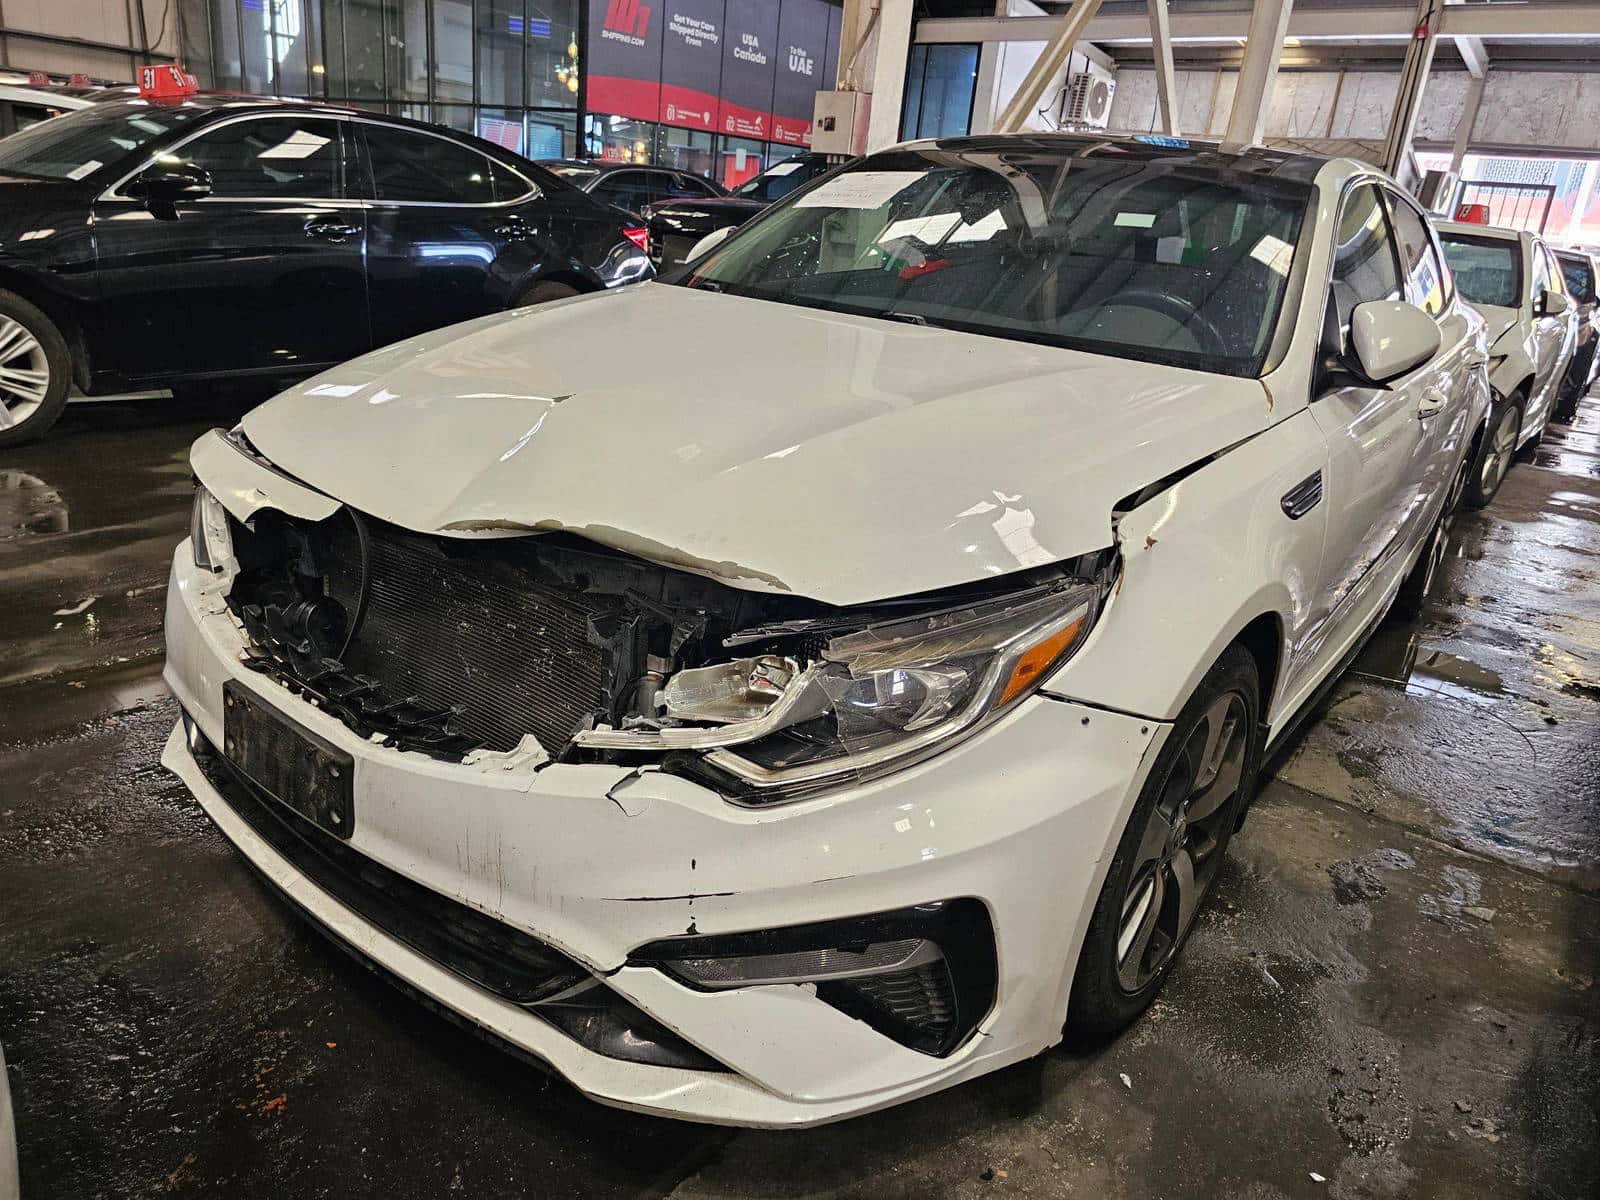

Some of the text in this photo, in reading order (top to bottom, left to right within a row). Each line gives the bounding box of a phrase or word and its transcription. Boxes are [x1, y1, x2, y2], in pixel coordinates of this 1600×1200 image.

[673, 14, 686, 24] Get
[686, 16, 700, 28] Your
[669, 22, 719, 45] Shipped Directly
[685, 36, 702, 47] From
[742, 33, 759, 48] USA
[734, 47, 767, 65] Canada
[789, 45, 807, 57] To the
[788, 54, 814, 76] UAE
[143, 68, 155, 90] 31
[169, 66, 186, 87] 31
